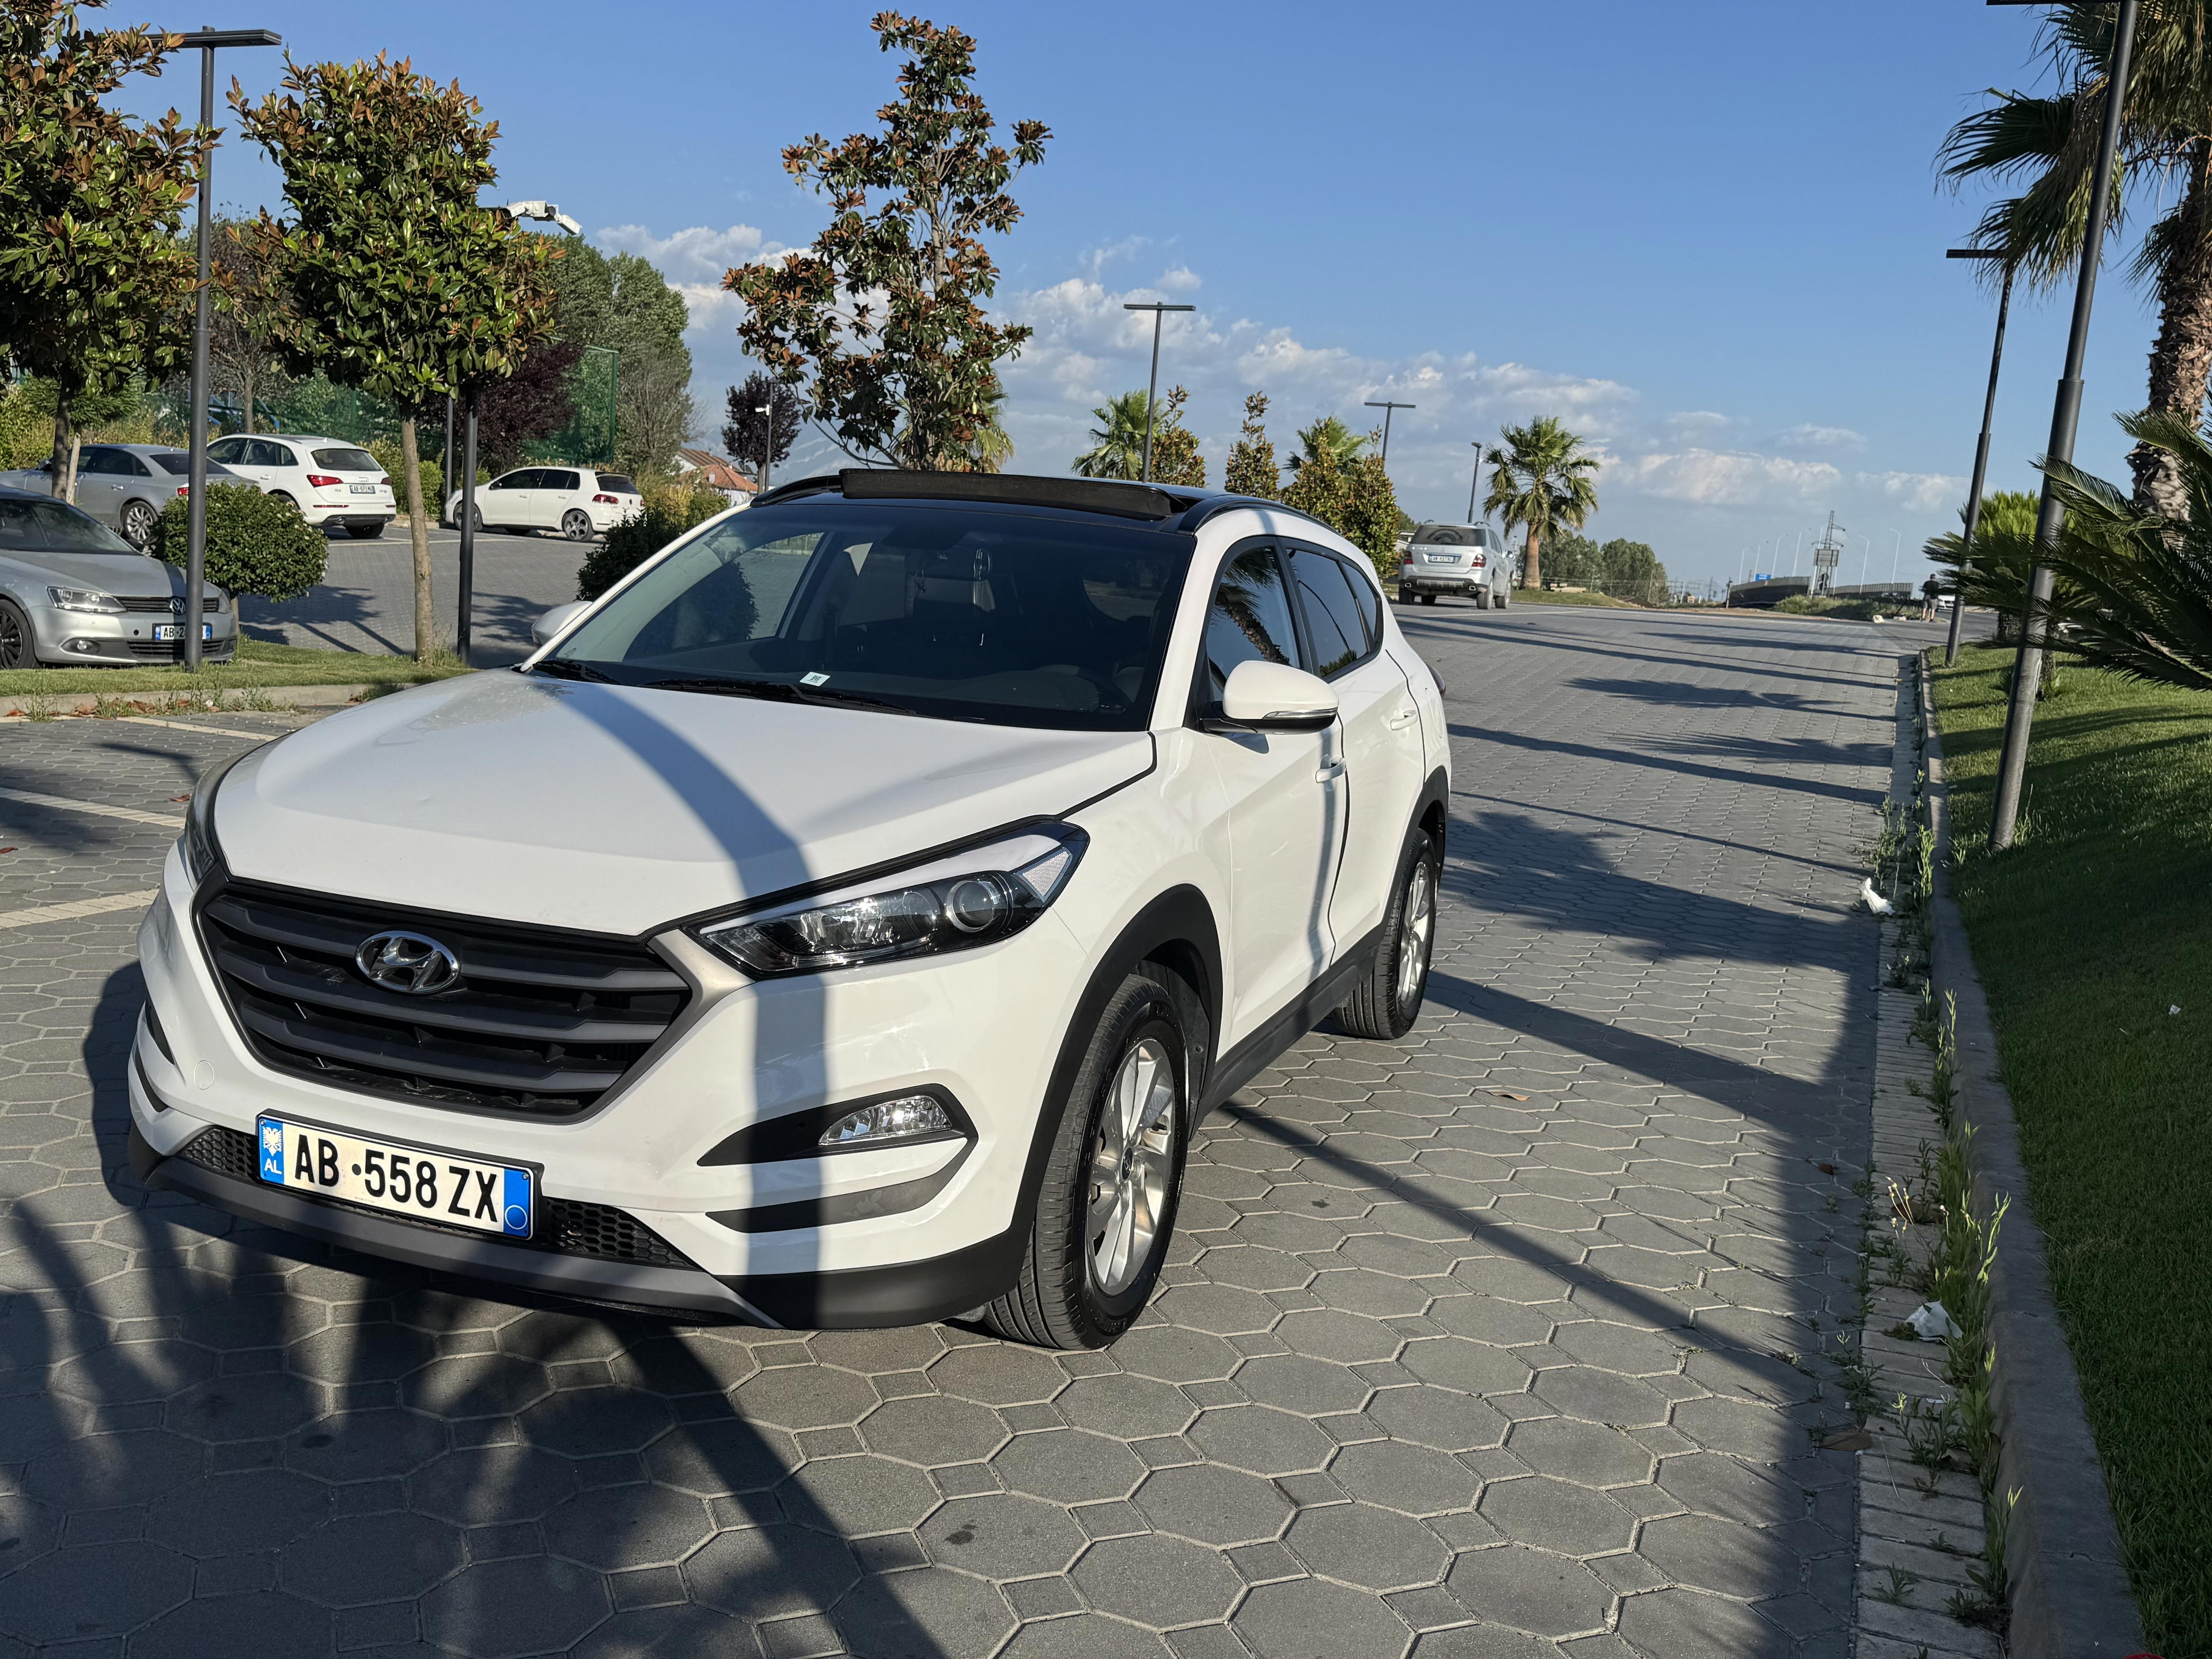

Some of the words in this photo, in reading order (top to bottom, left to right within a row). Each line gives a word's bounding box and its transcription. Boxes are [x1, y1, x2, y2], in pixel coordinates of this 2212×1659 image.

[164, 627, 174, 637] AB
[264, 1158, 282, 1175] AL
[294, 1134, 340, 1187] AB
[364, 1149, 438, 1209] 558
[448, 1166, 498, 1223] ZX
